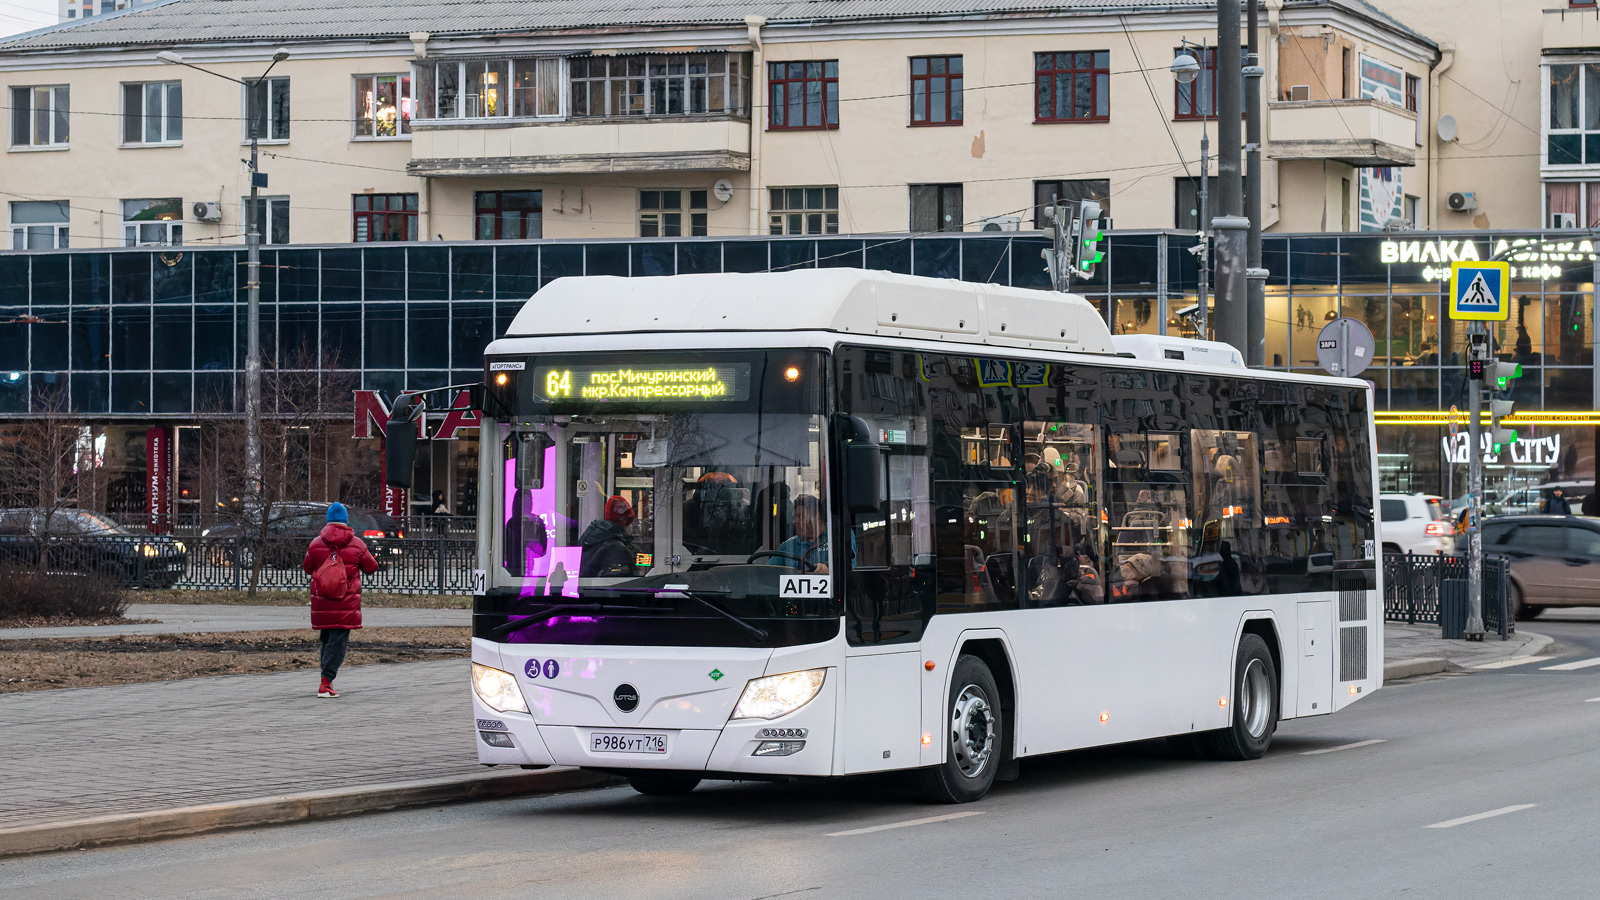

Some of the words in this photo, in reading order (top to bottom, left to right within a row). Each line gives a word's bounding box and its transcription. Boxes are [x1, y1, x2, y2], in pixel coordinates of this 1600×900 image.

[1380, 240, 1480, 263] ВИЛКА
[1522, 263, 1562, 281] кафе
[546, 370, 571, 397] 64
[591, 367, 716, 385] пос.Мичуринский
[582, 380, 725, 398] мкр.Компрессорный
[1510, 433, 1560, 463] CITY
[385, 484, 394, 517] АГНУ
[783, 578, 828, 594] АП-2
[594, 735, 642, 751] Р986УТ
[645, 735, 664, 748] 716
